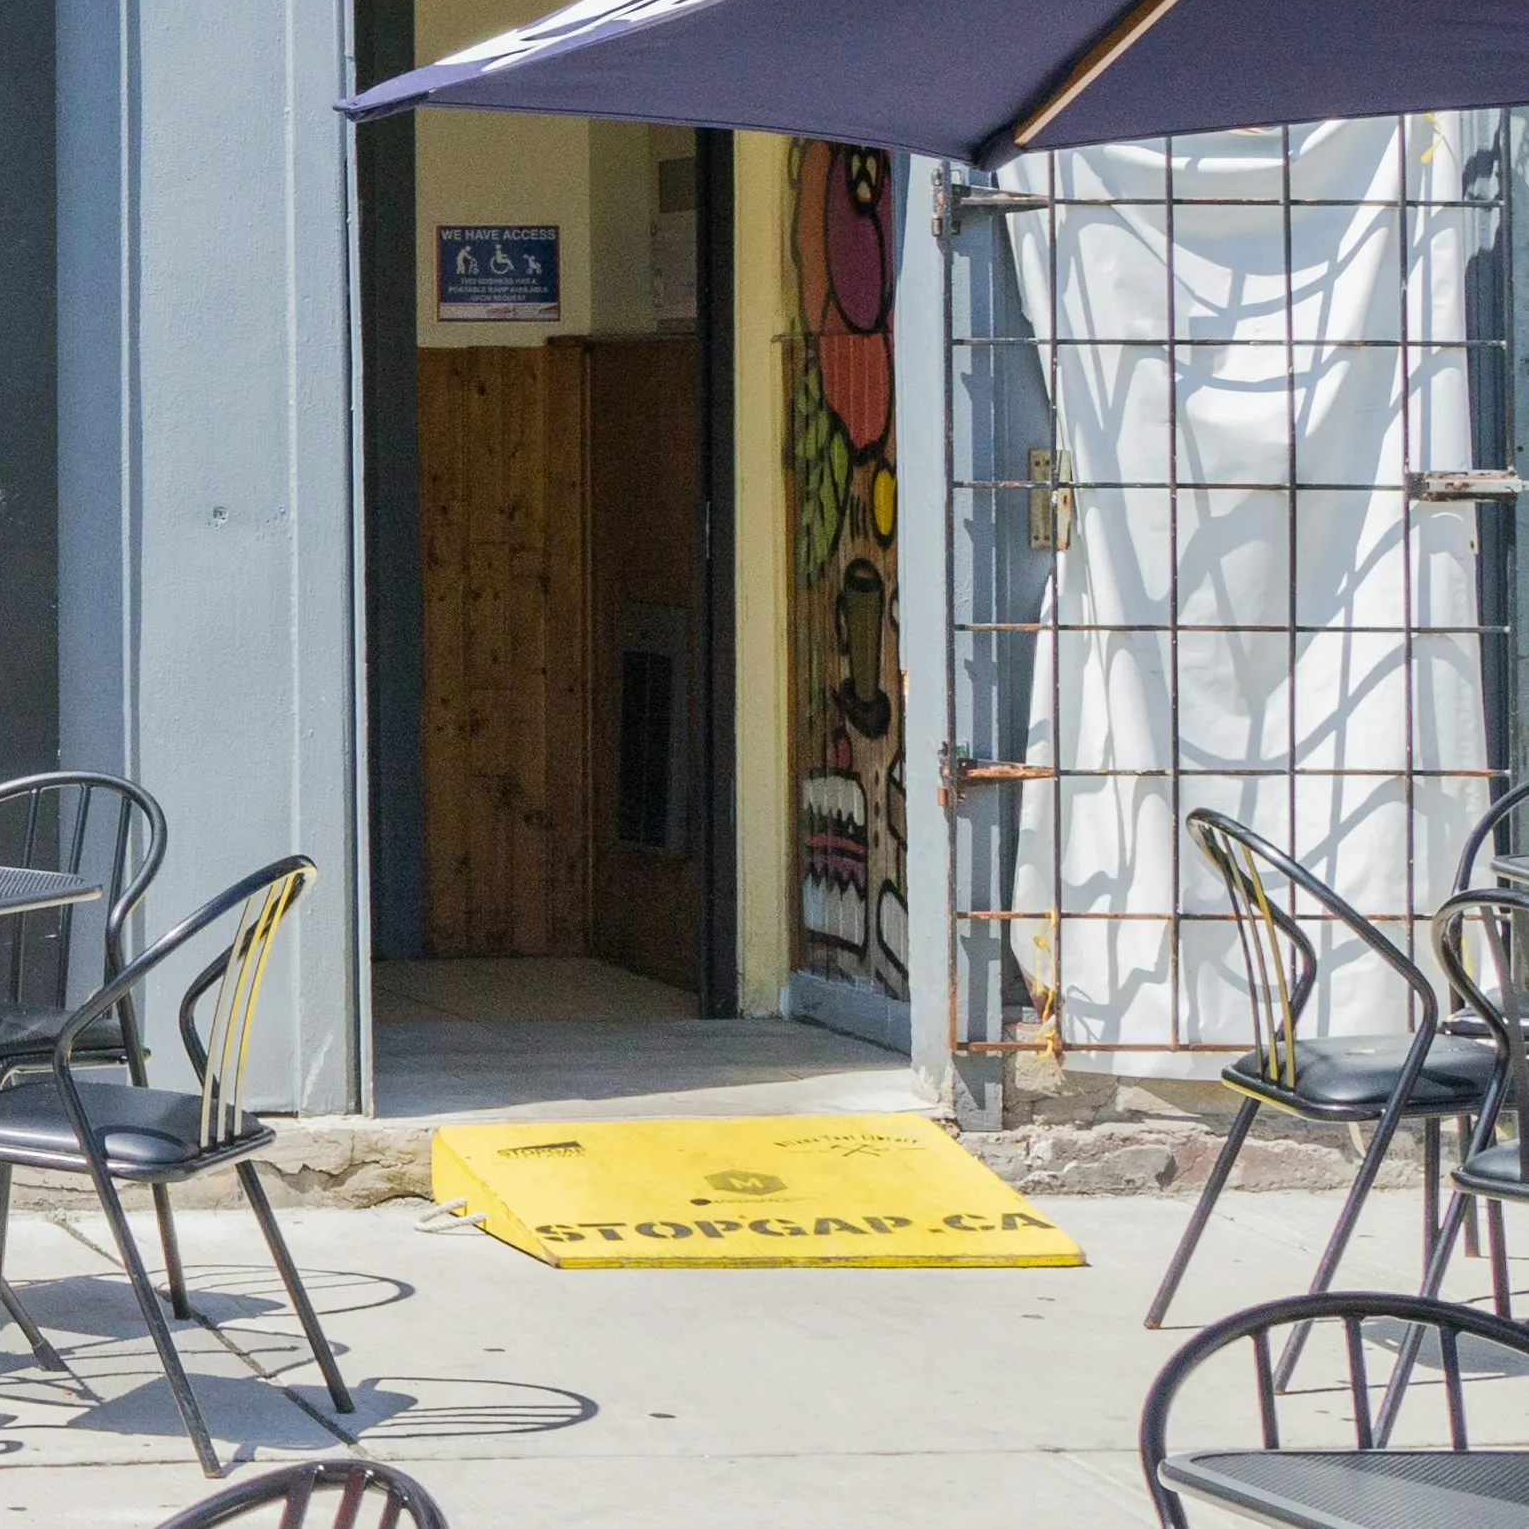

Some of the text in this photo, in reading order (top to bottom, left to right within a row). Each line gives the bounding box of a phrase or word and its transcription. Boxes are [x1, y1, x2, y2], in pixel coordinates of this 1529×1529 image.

[441, 229, 556, 240] WE HAVE ACCESS
[535, 1212, 1057, 1243] STOPGAP.CA
